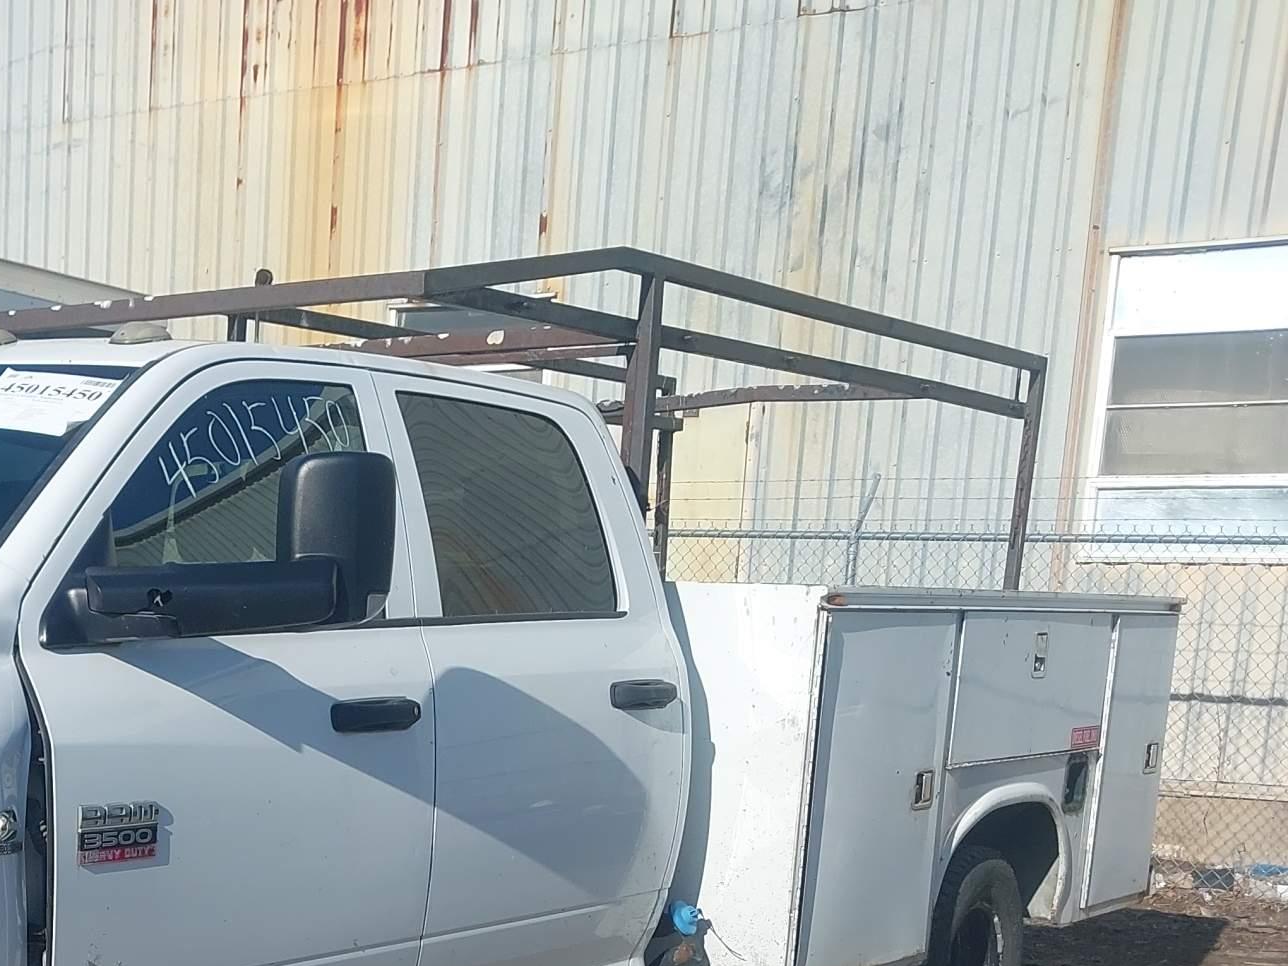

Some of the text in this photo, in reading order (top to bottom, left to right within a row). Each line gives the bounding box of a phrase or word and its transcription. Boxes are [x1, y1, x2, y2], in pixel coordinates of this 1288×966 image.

[0, 382, 103, 401] 45015450
[158, 395, 350, 498] 45015450
[83, 828, 153, 850] 3500
[124, 845, 150, 858] DUTY
